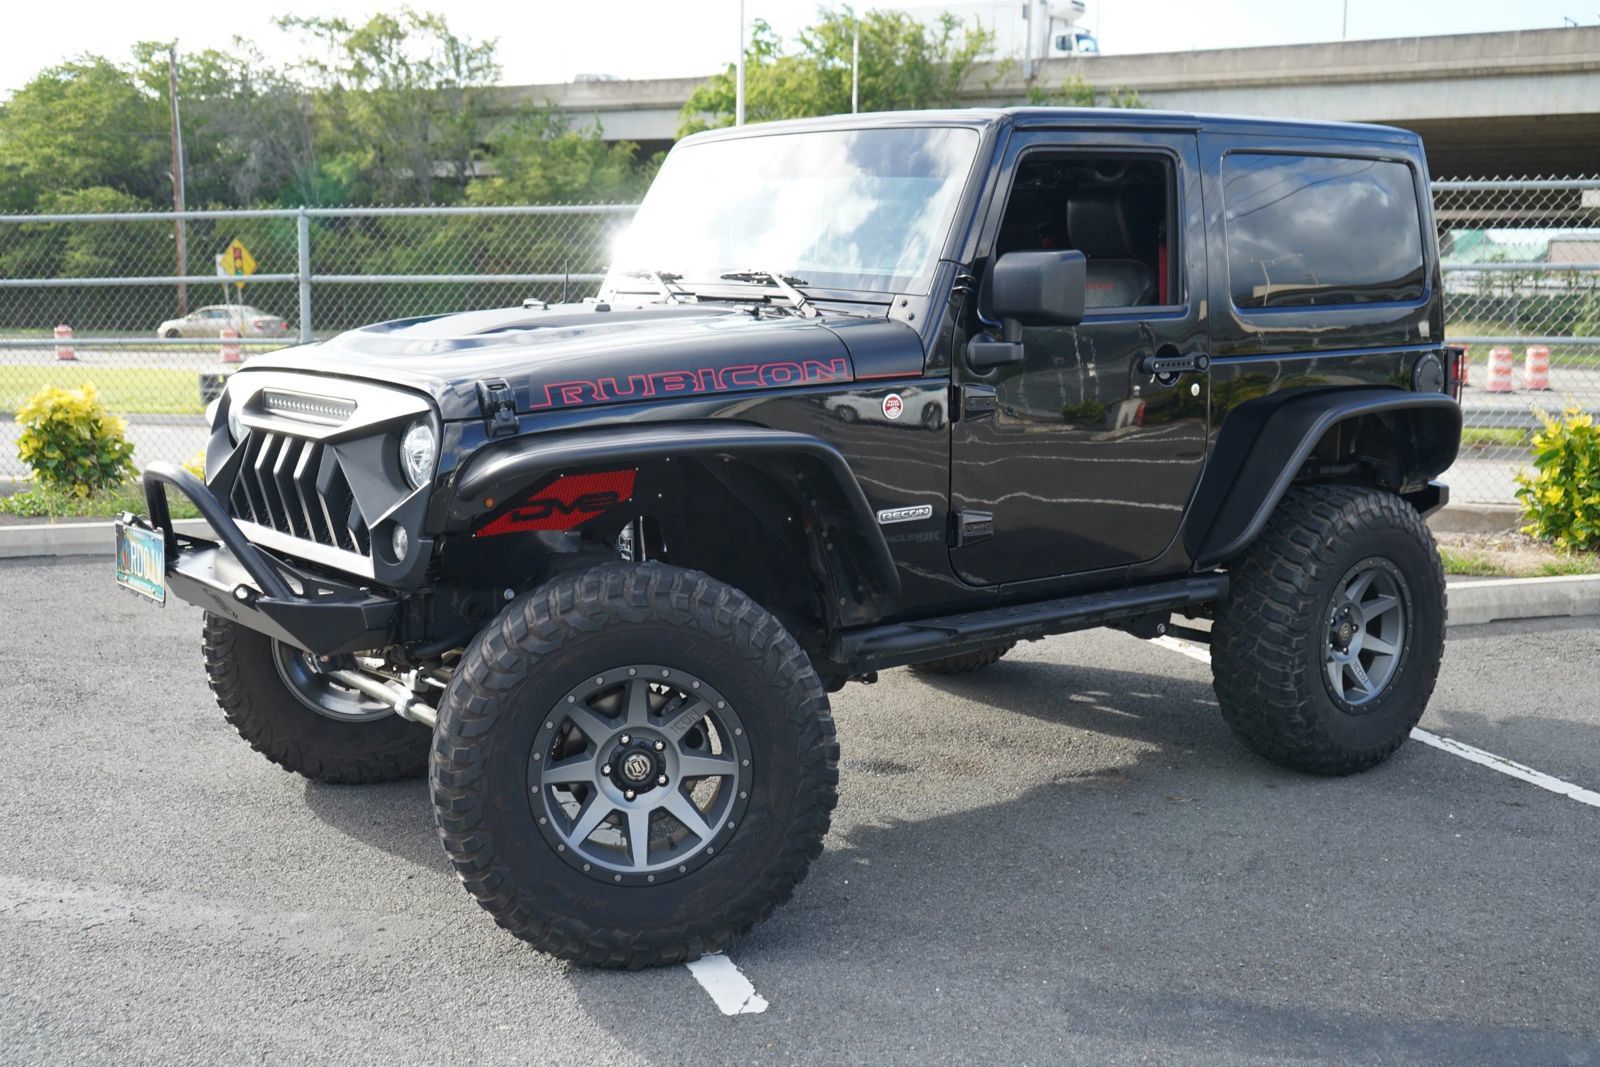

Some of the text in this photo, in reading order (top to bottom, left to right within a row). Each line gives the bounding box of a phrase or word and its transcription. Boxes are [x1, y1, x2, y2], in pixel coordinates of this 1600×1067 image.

[530, 358, 848, 408] RUBICON
[882, 508, 929, 520] RECON
[671, 710, 699, 735] ICON
